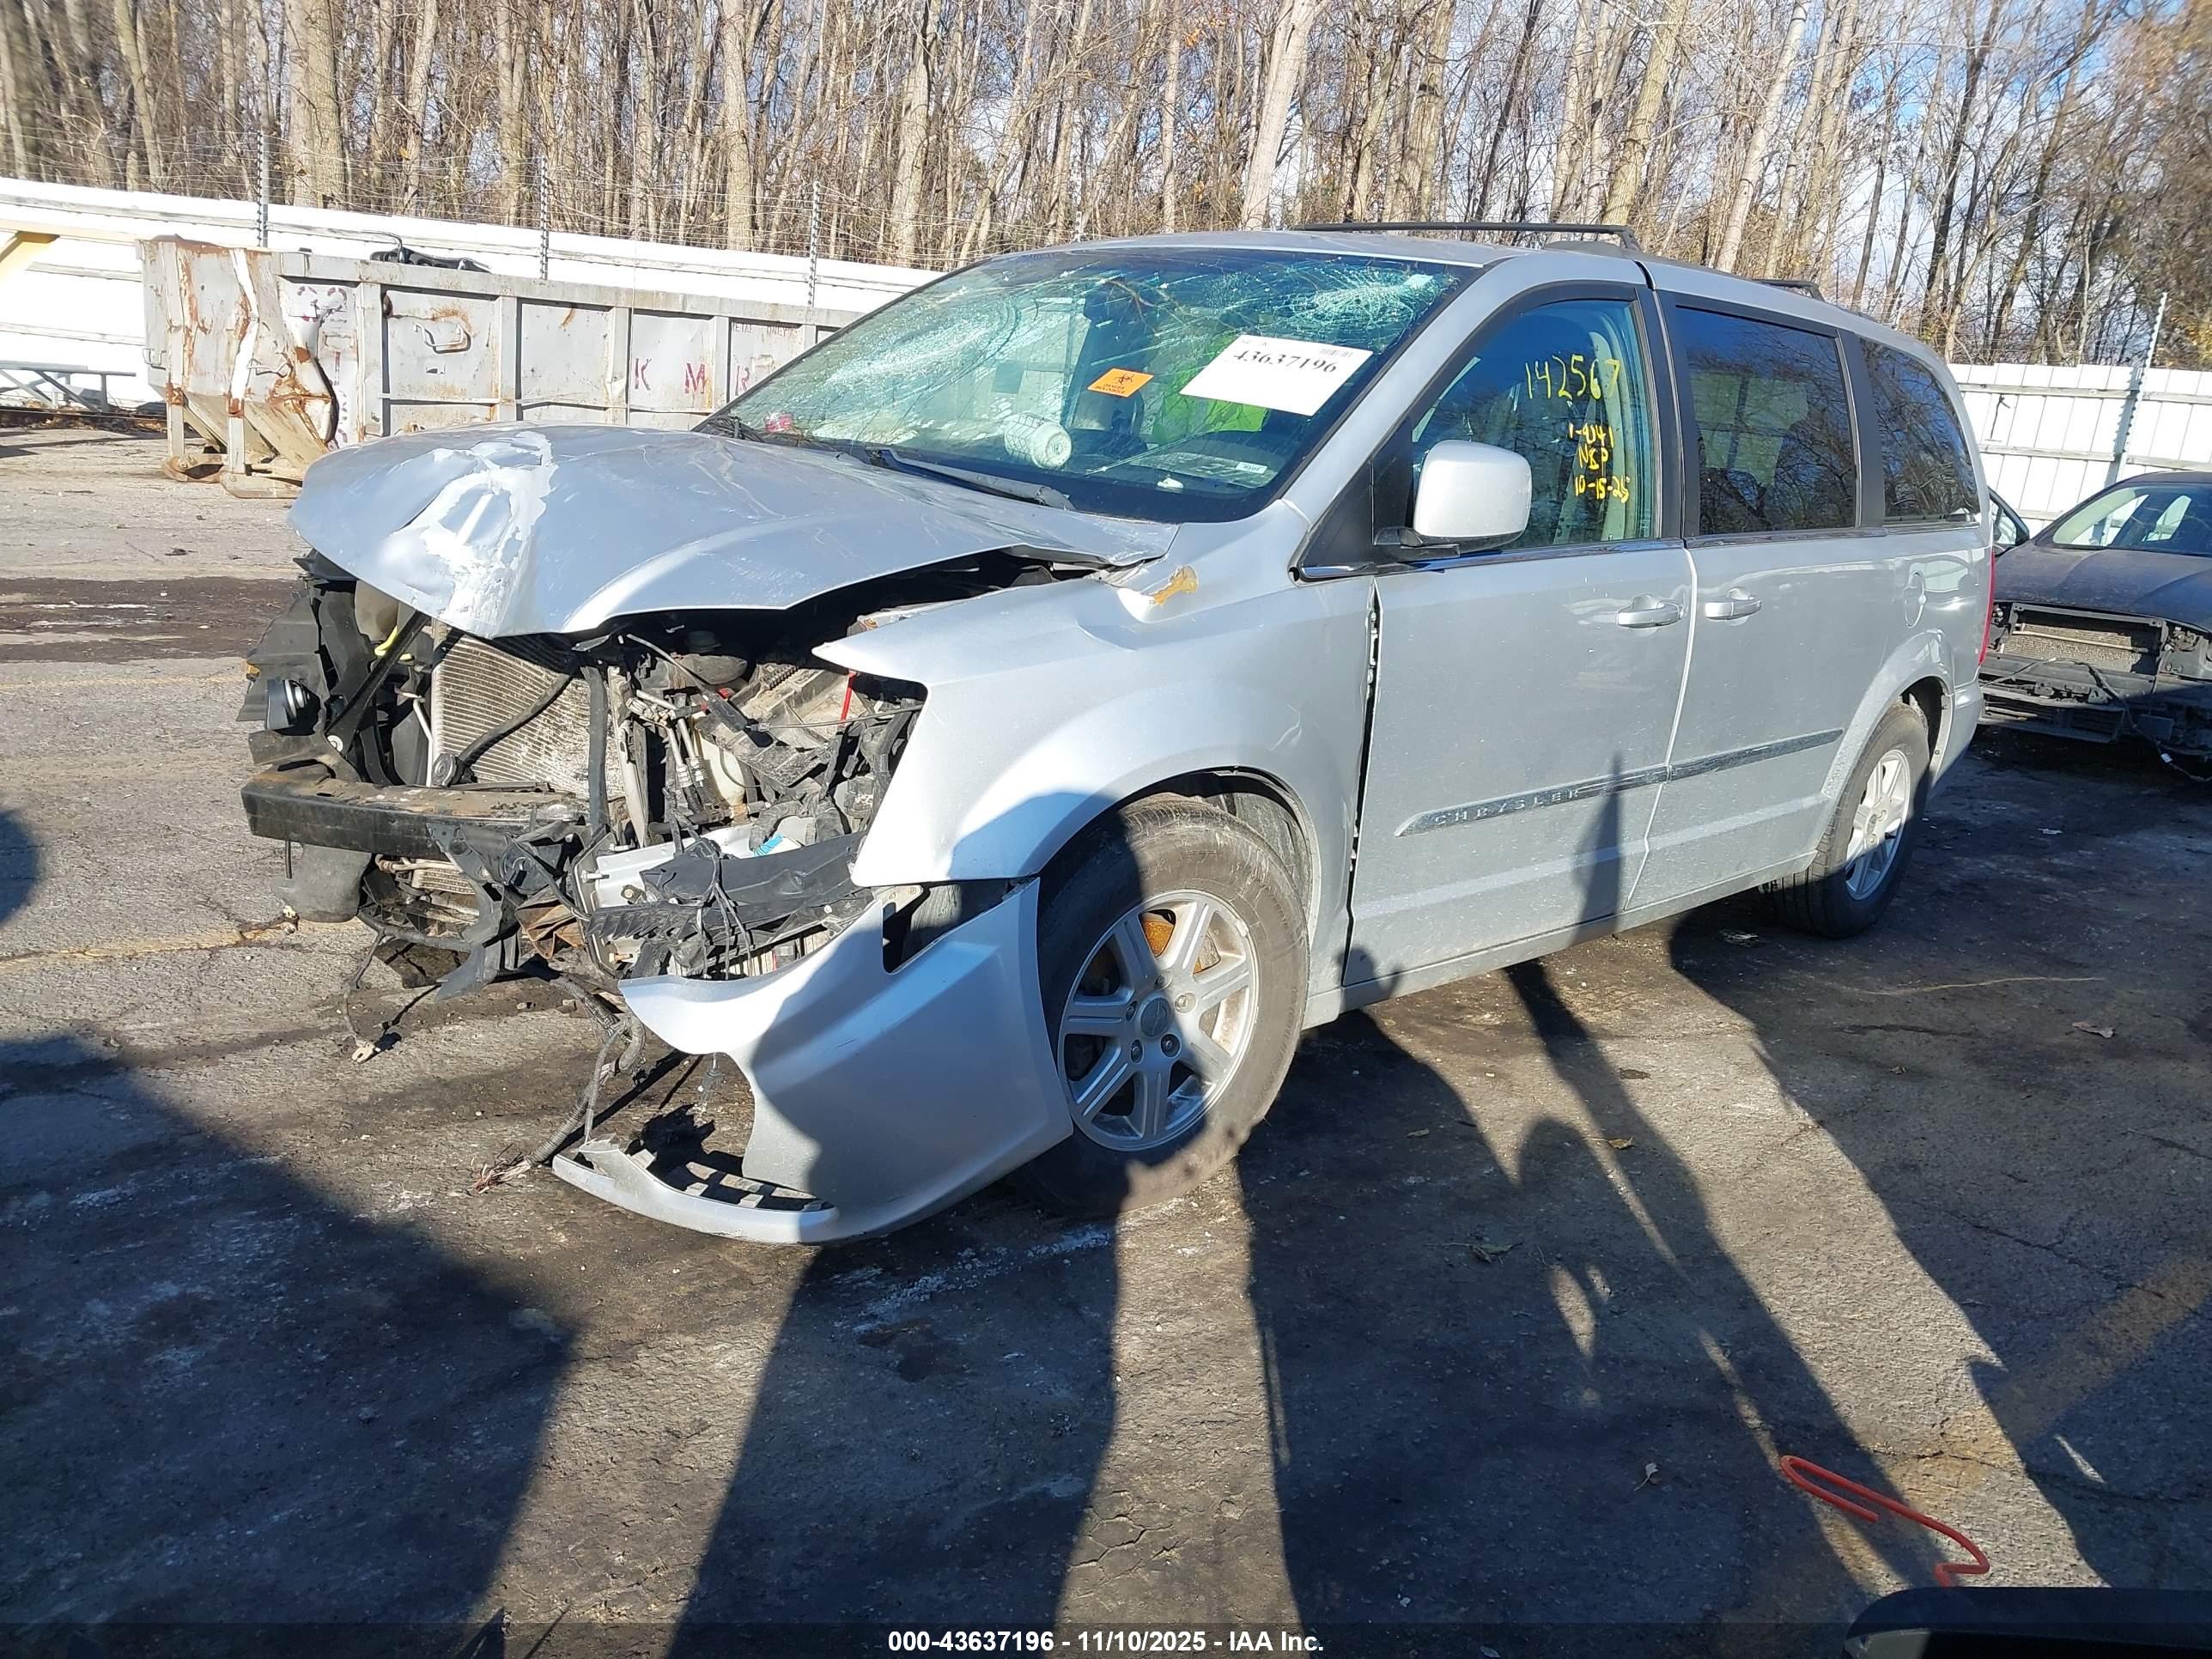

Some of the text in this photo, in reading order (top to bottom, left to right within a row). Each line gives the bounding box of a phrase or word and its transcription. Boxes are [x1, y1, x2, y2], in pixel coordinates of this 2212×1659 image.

[1233, 349, 1337, 373] 43637196
[1525, 354, 1620, 399] 142567
[1435, 788, 1579, 825] CHRYSLER
